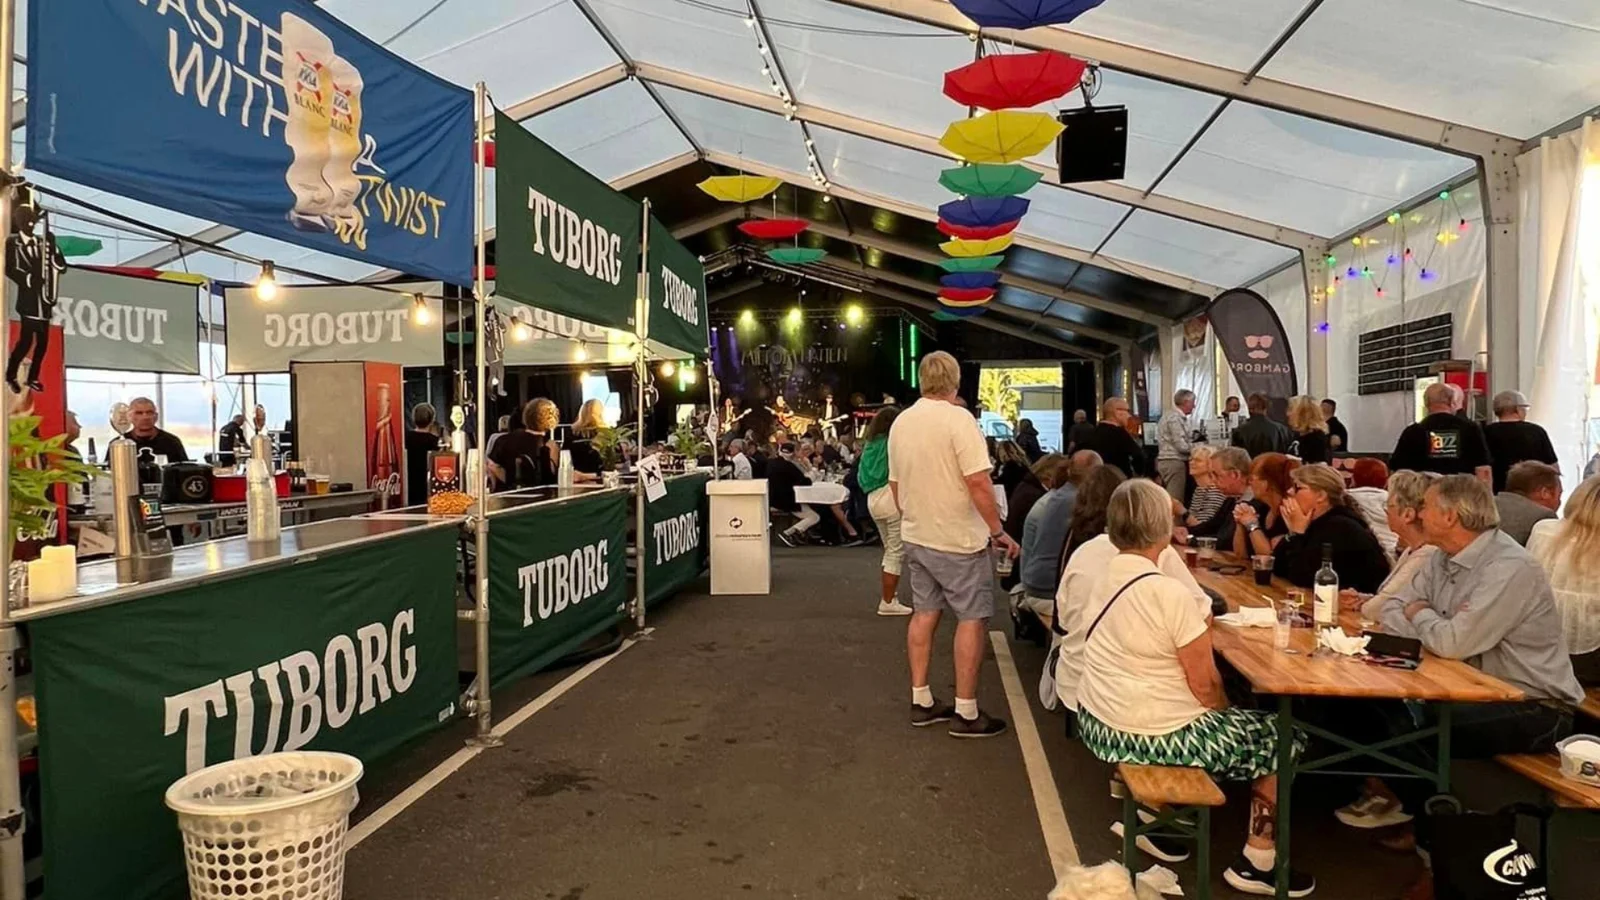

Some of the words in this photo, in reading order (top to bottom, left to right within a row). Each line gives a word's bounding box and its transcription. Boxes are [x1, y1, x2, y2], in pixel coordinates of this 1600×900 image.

[134, 0, 284, 87] ASTE
[352, 134, 387, 174] A
[356, 174, 446, 239] TWIST
[528, 186, 622, 285] TUBORG
[662, 264, 699, 326] TUBORG
[653, 509, 700, 565] TUBORG
[518, 539, 609, 628] TUBORG
[163, 608, 417, 776] TUBORG
